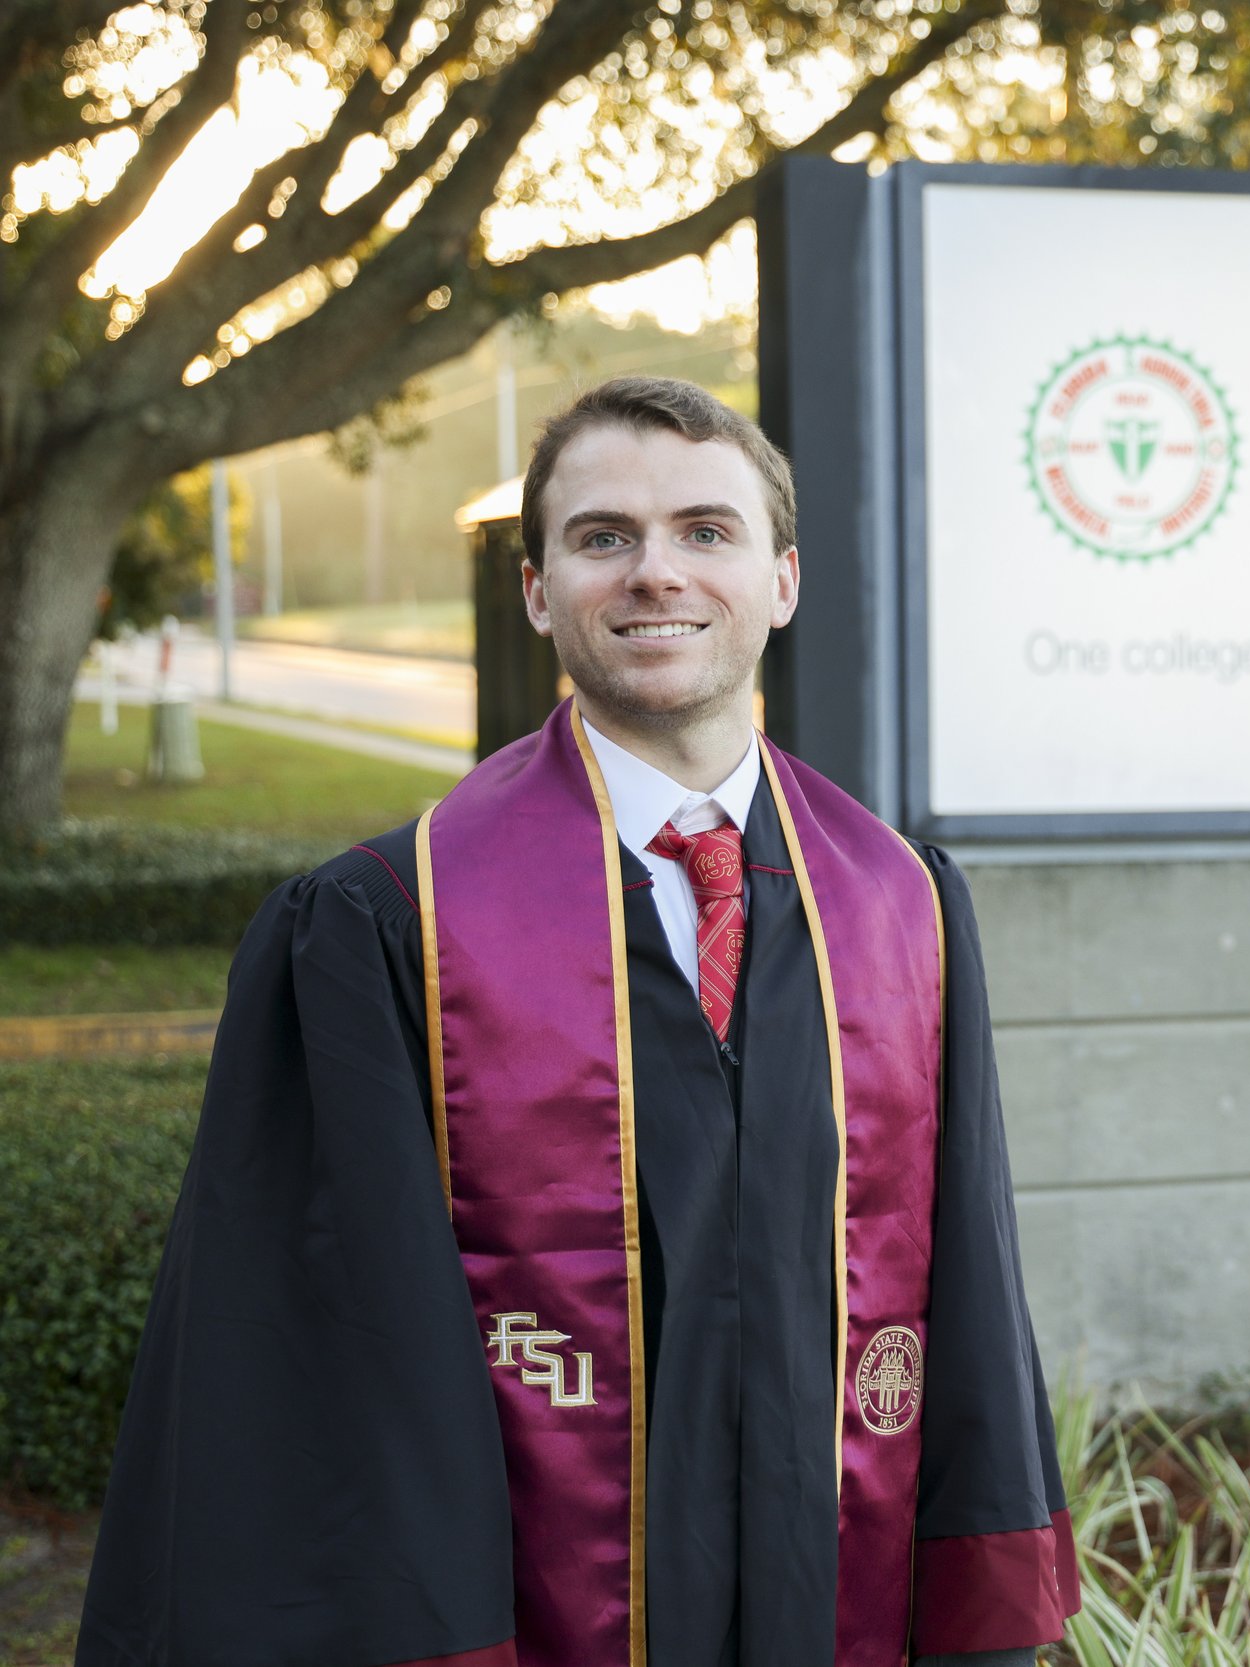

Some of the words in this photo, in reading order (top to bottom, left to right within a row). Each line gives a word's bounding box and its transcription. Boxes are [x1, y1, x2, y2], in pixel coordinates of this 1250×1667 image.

[1024, 627, 1111, 675] One
[487, 1311, 598, 1407] FSU
[859, 1351, 877, 1409] FLORIDA
[876, 1333, 903, 1350] STATE
[905, 1338, 921, 1409] UNIVERSITY
[878, 1417, 898, 1429] 1851
